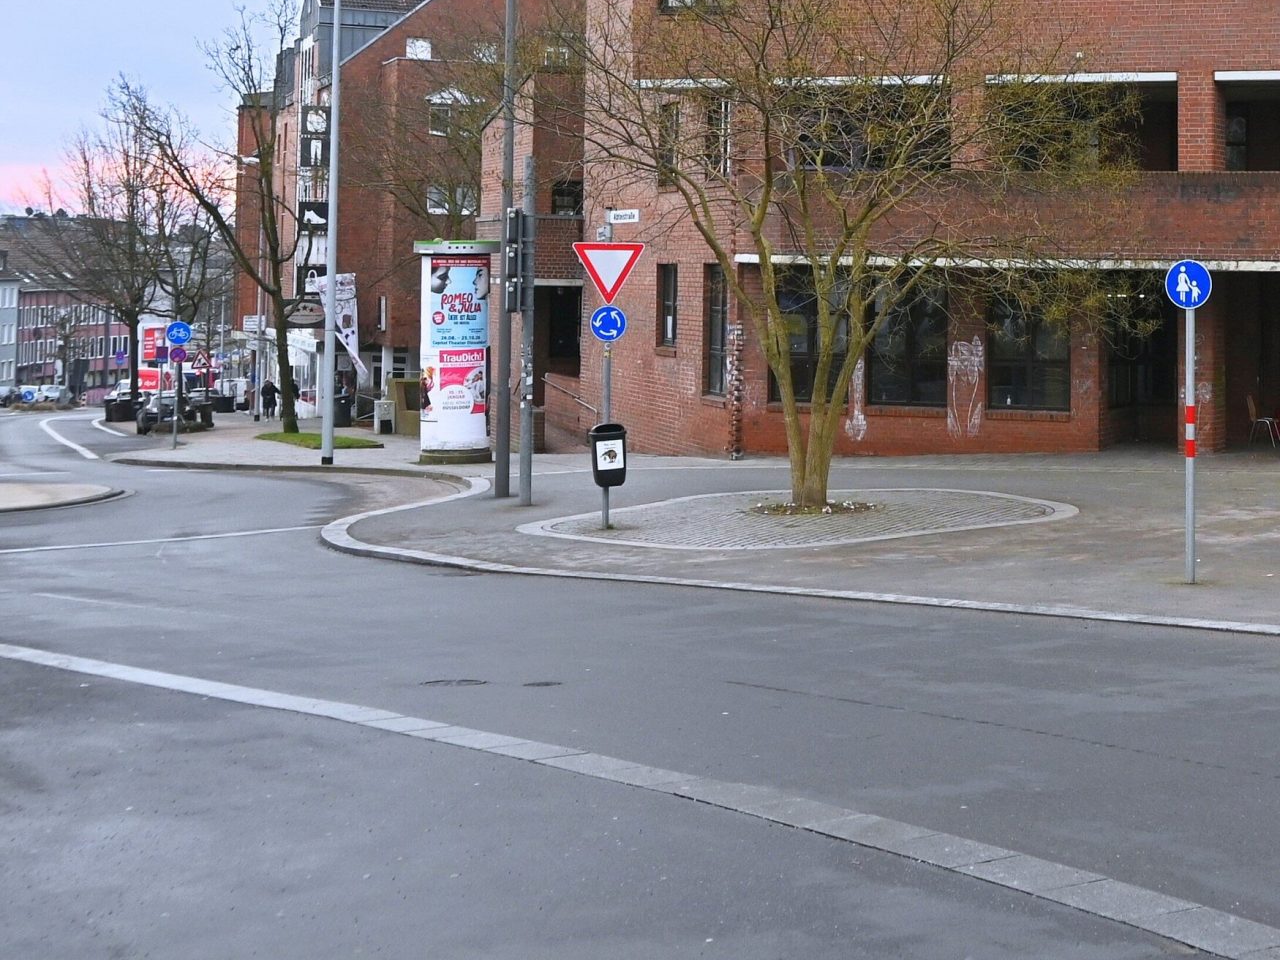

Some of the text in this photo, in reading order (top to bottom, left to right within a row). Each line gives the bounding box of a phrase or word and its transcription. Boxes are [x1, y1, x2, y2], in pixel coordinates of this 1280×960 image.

[441, 293, 473, 310] ROMEO
[449, 303, 482, 314] & JULIA
[443, 352, 482, 362] TrauDich!
